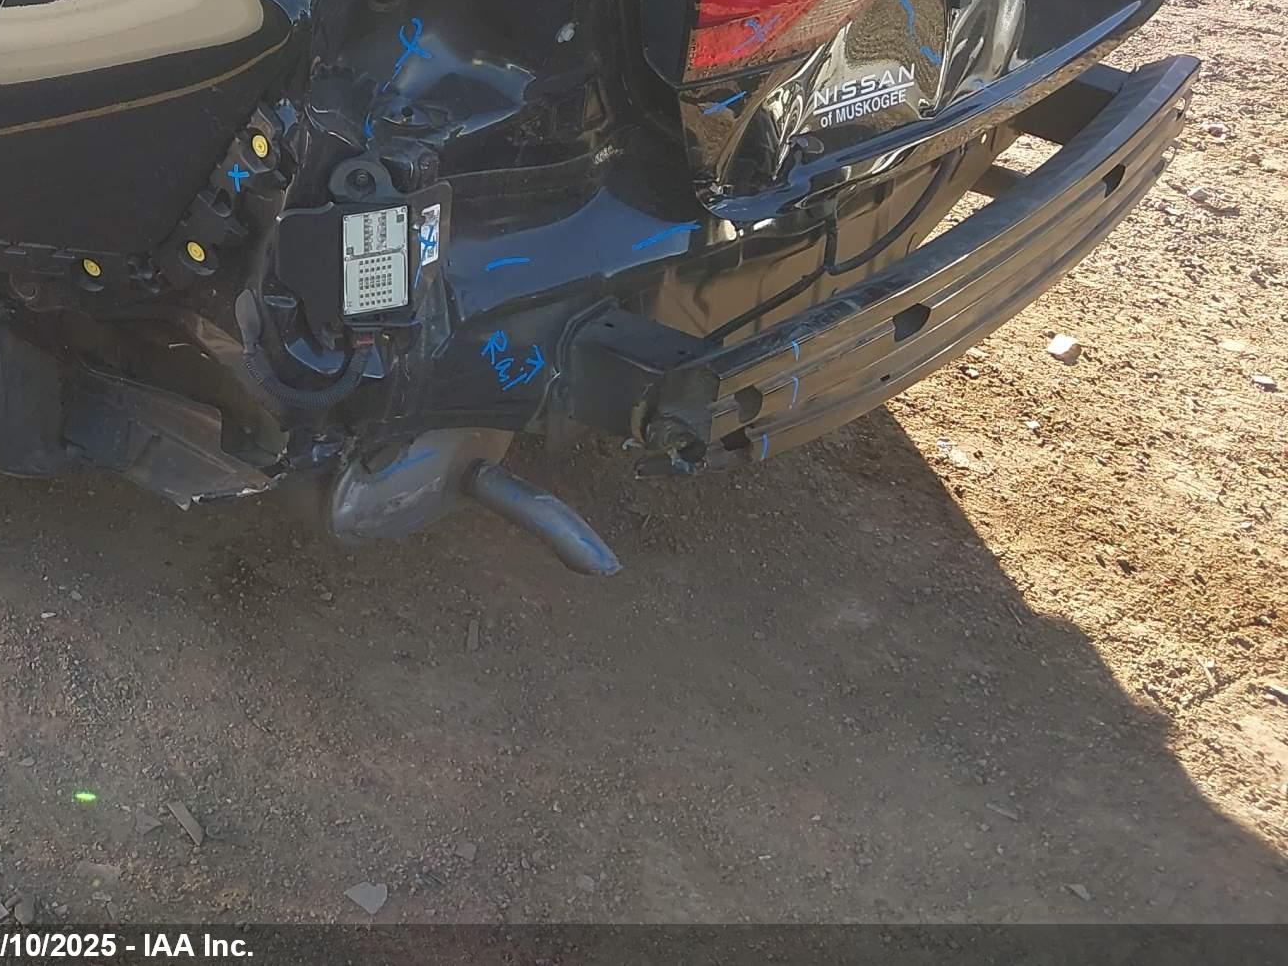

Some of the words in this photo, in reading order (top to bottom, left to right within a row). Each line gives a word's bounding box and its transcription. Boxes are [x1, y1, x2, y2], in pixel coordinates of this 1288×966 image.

[812, 62, 915, 109] NISSAN
[820, 111, 833, 128] of
[835, 89, 906, 124] MUSKOGEE
